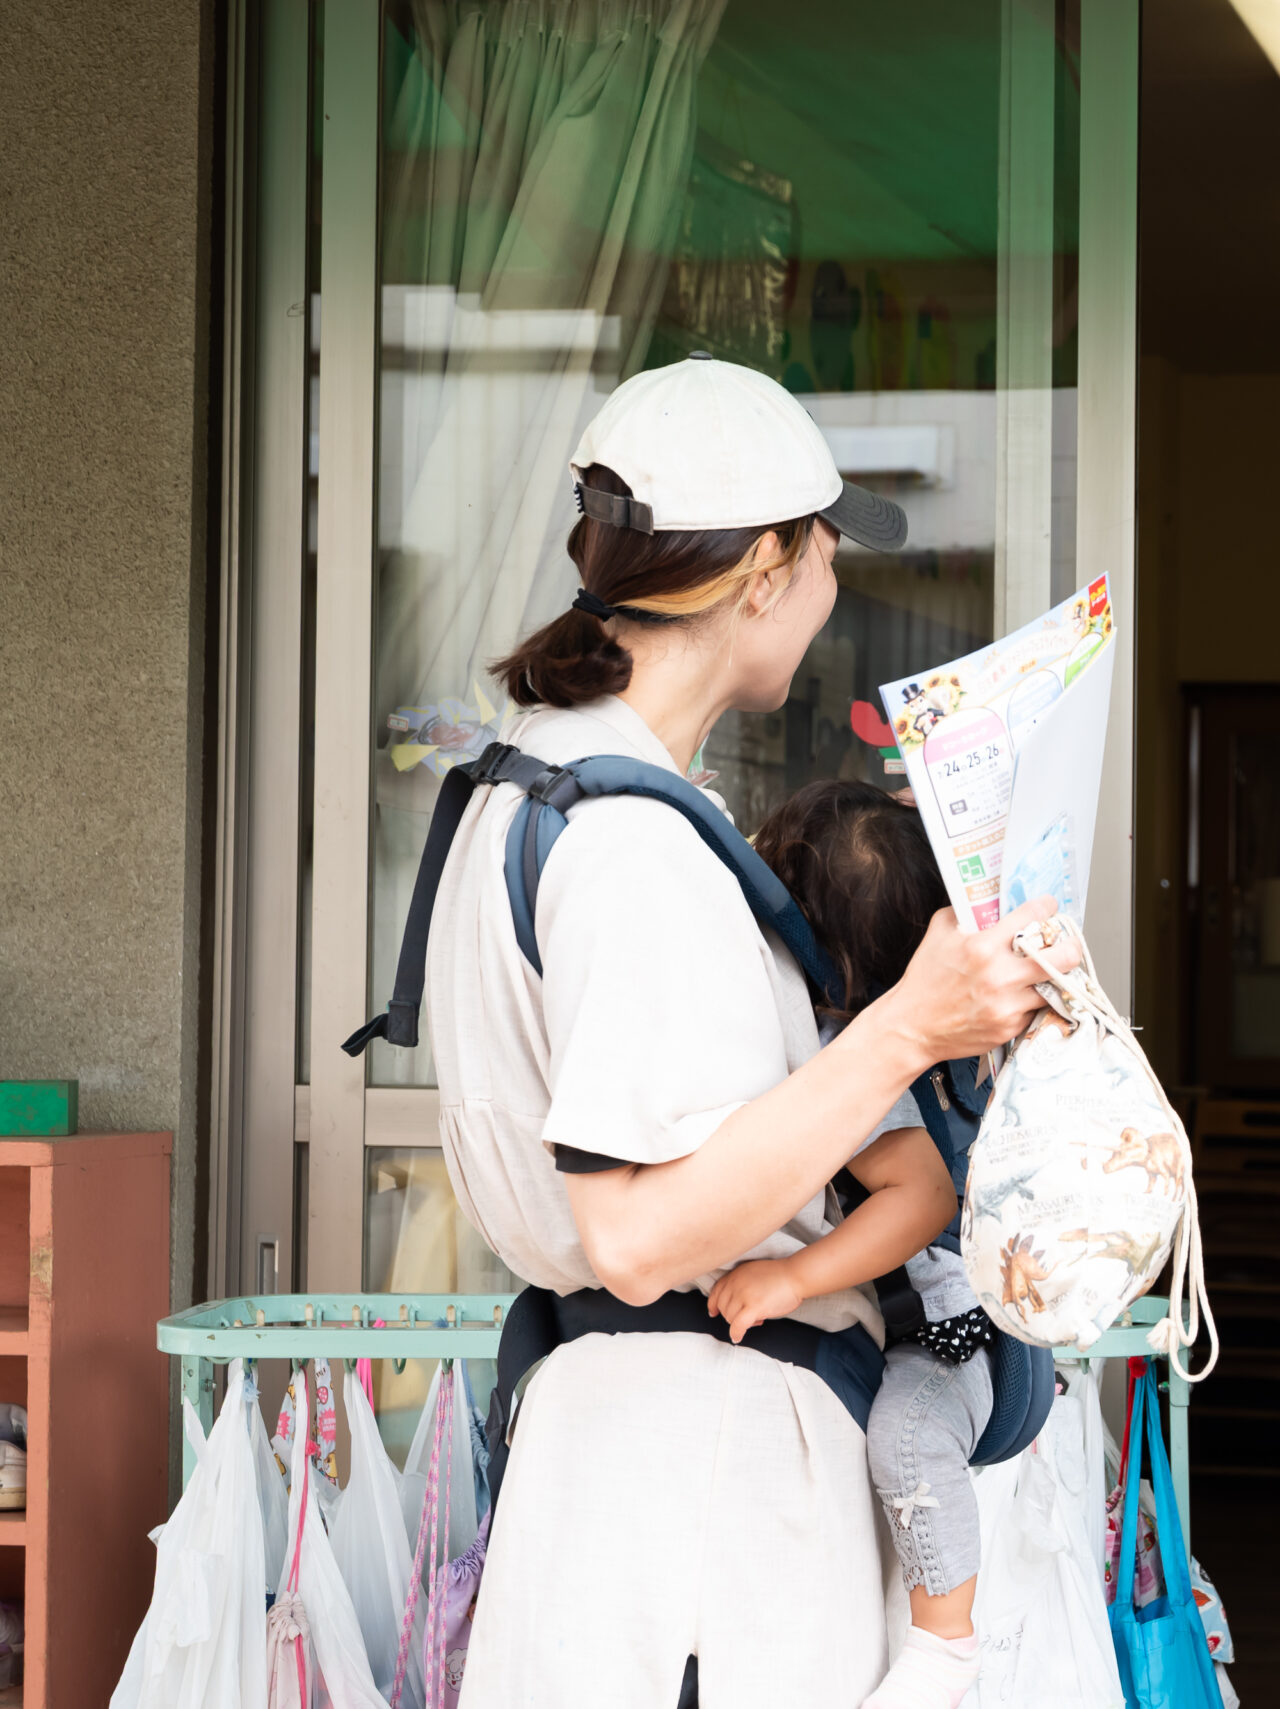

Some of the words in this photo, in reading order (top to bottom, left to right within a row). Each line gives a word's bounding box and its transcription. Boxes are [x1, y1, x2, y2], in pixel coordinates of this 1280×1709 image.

[943, 760, 960, 776] 24
[966, 751, 981, 769] 25
[985, 743, 1000, 760] 26
